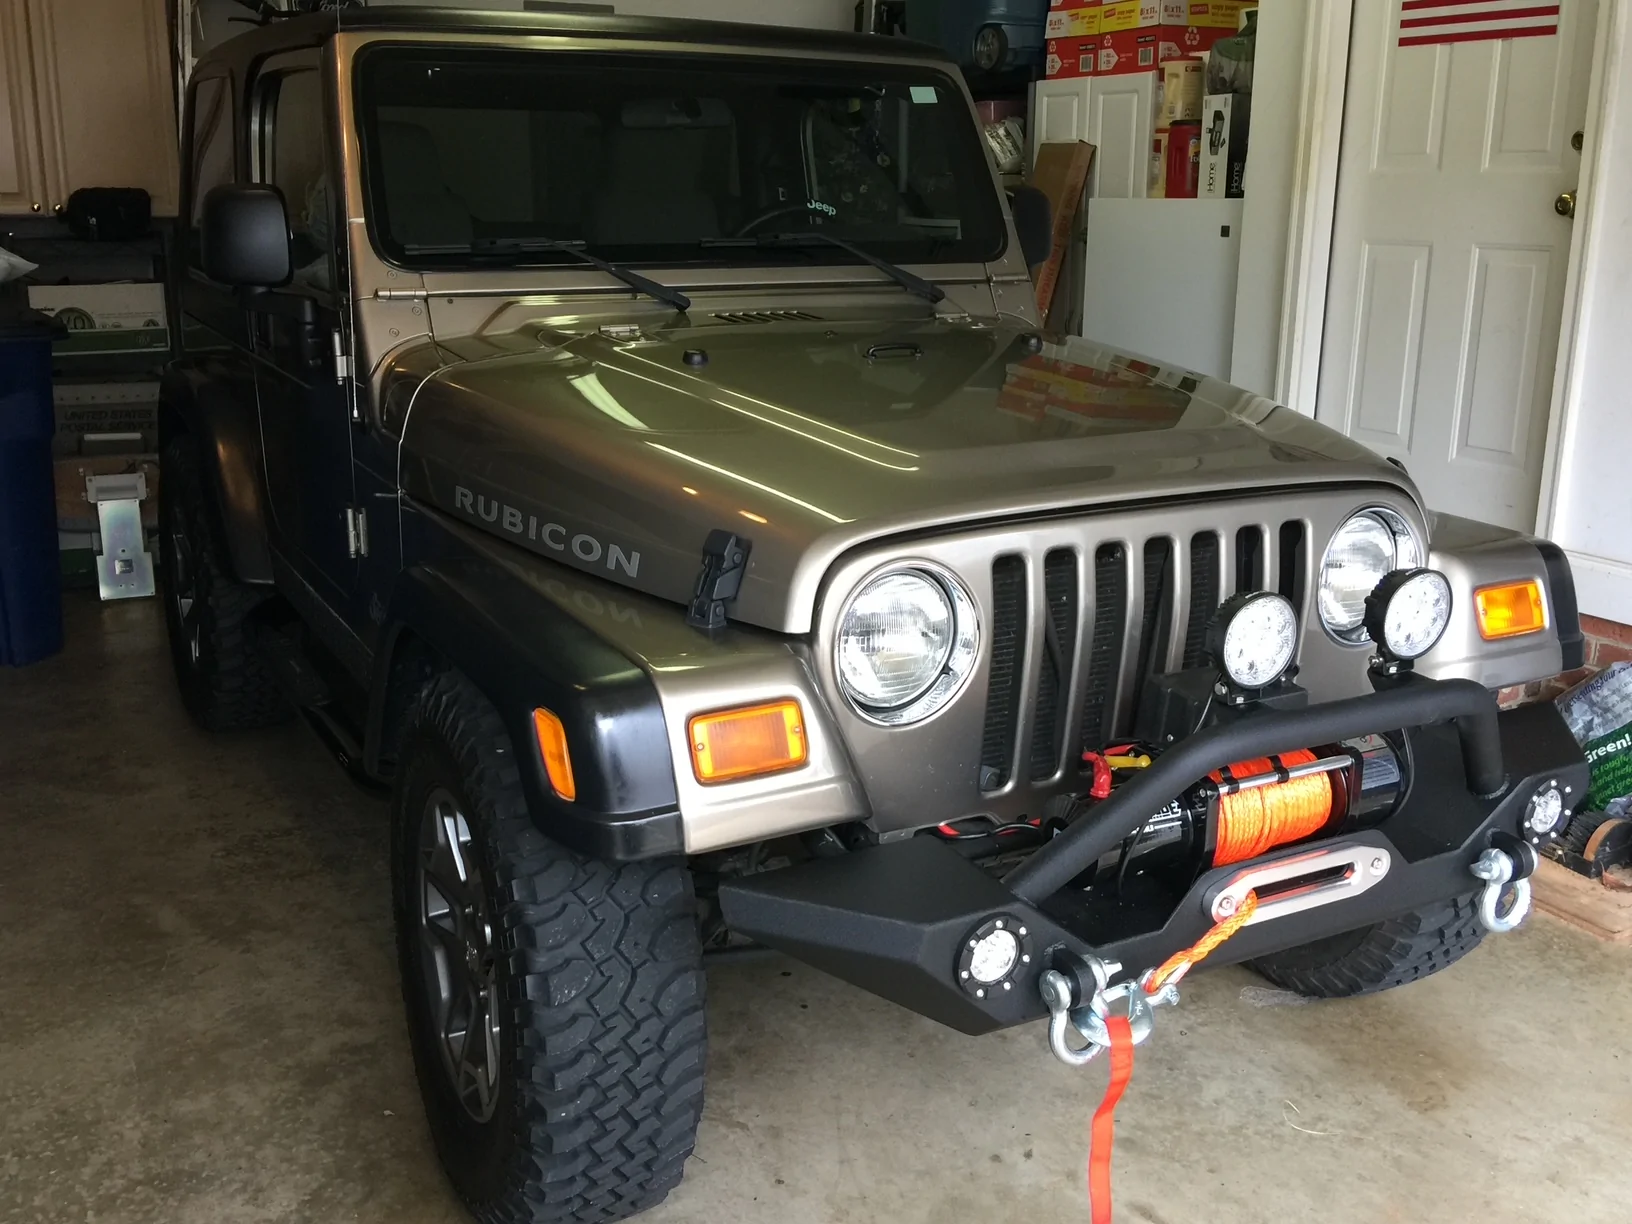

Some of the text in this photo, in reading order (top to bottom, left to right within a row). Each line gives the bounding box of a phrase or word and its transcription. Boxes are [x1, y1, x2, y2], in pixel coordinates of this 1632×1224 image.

[806, 199, 837, 216] Jeep
[65, 409, 153, 420] UNITED STATES
[60, 422, 104, 433] POSTAL
[455, 485, 641, 578] RUBICON
